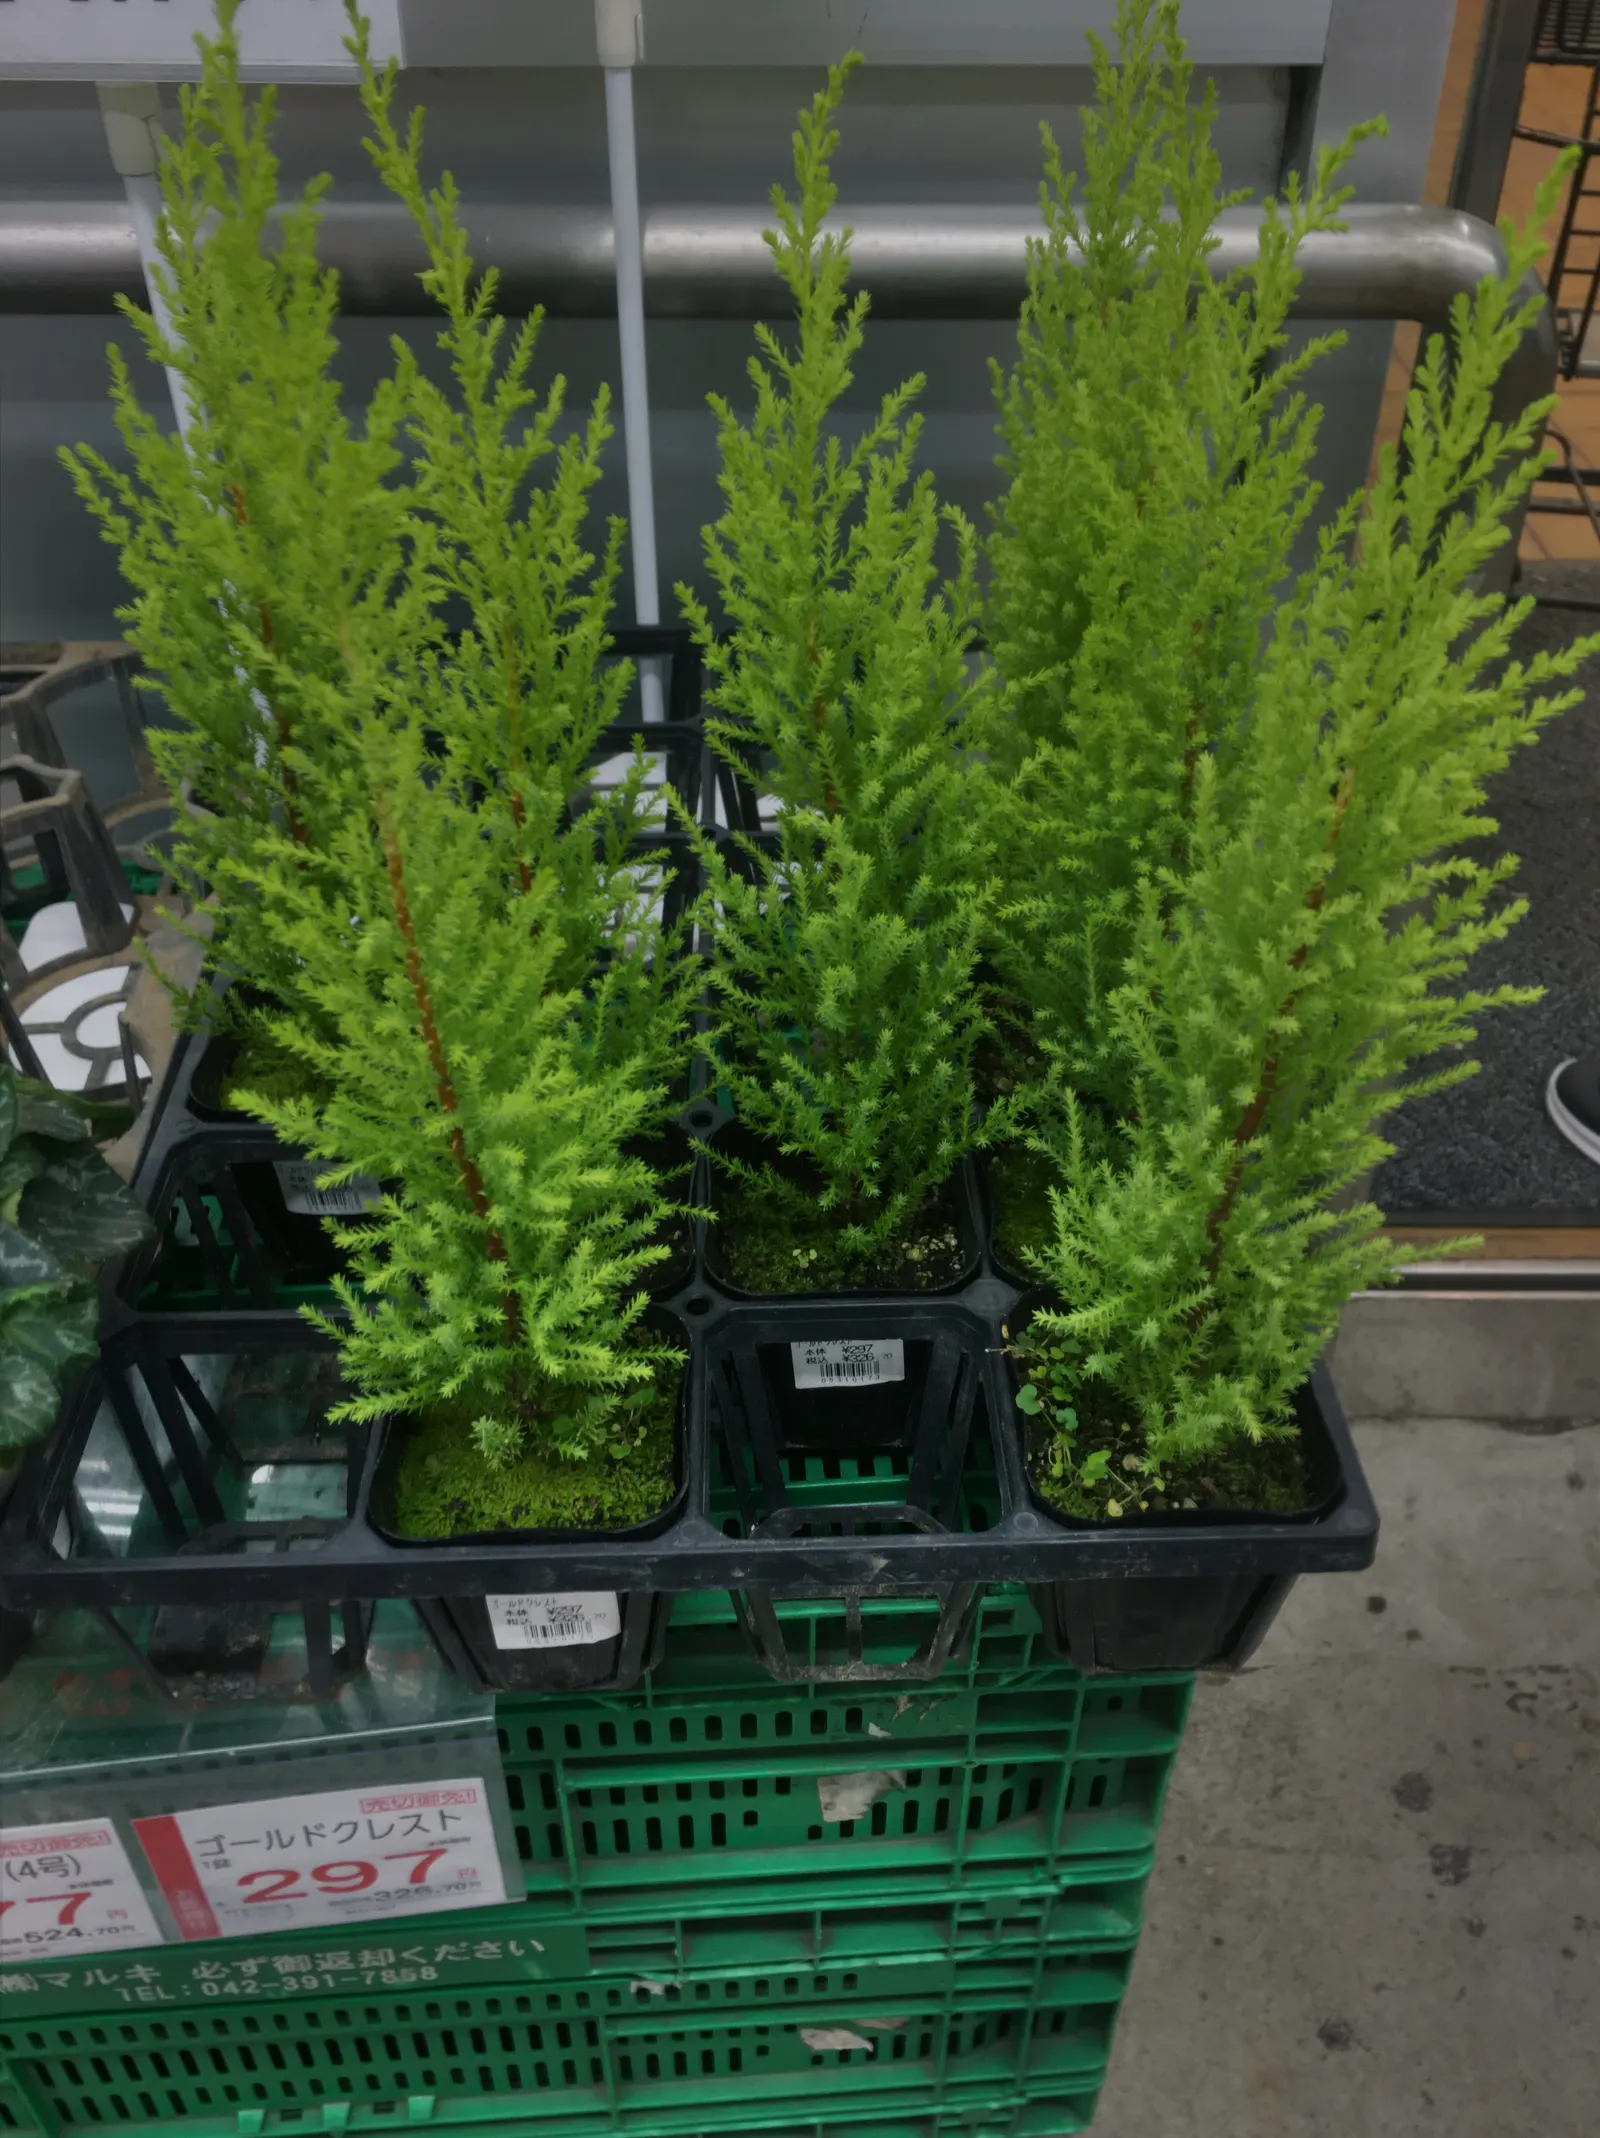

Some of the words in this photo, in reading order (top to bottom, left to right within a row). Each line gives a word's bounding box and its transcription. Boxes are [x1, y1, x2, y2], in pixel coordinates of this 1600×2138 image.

[195, 1810, 462, 1857] ゴールドクレスト
[4, 1853, 82, 1883] (4号)
[236, 1848, 449, 1905] 297
[191, 1939, 545, 1981] 必ず御返却ください
